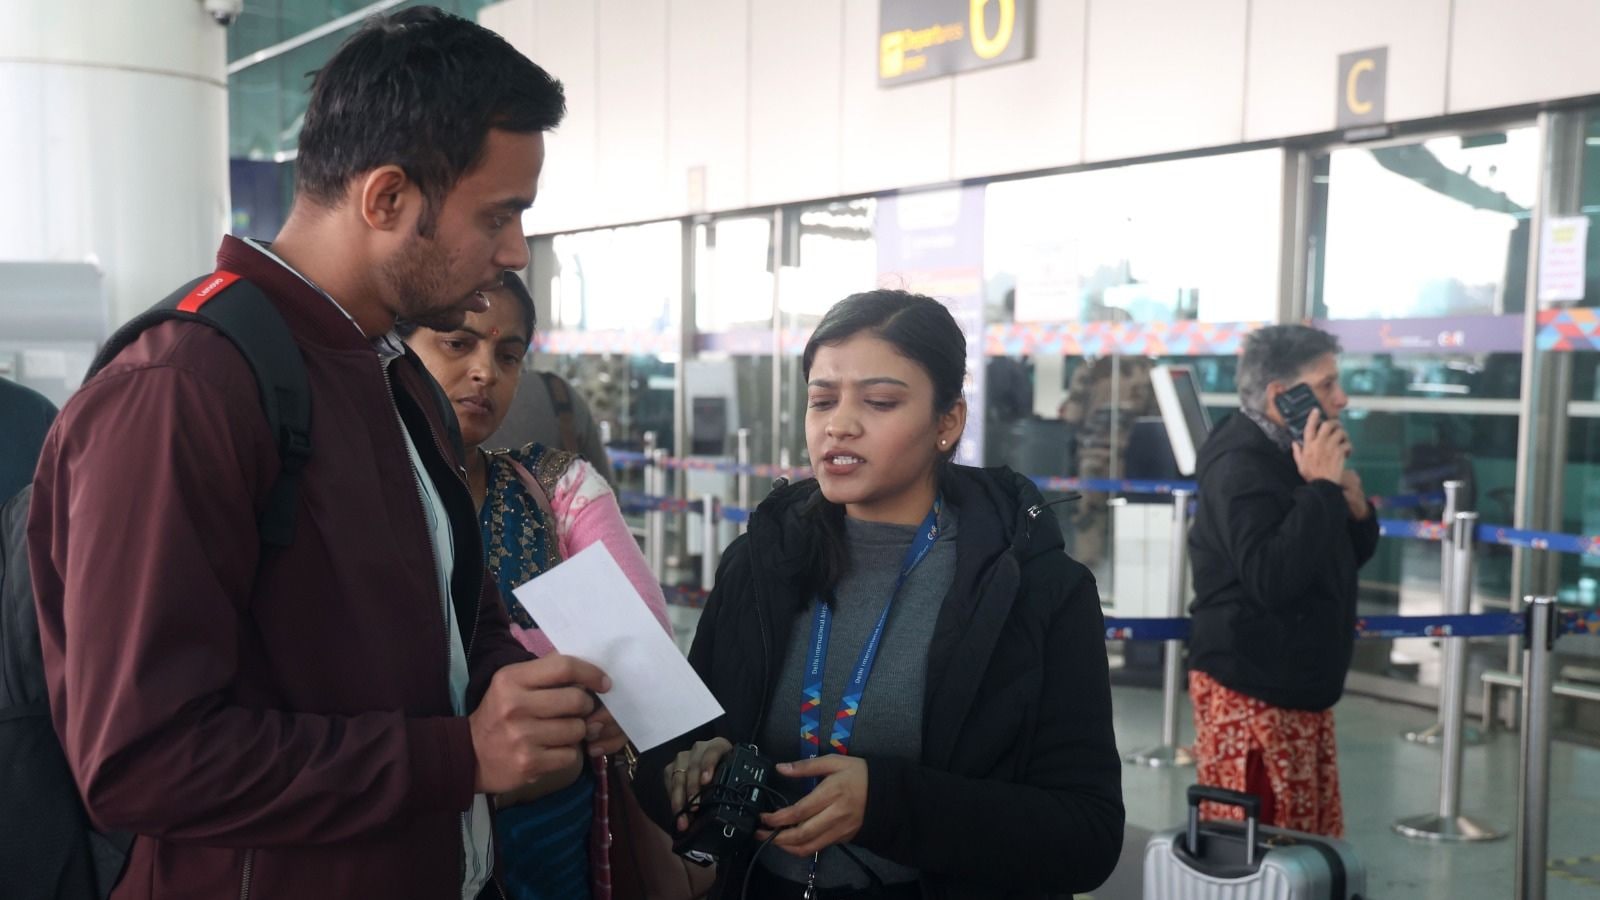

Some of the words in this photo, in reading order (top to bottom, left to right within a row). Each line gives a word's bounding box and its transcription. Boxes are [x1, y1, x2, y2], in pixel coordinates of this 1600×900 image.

[1346, 57, 1376, 115] C
[196, 278, 224, 297] Lenovo
[814, 620, 825, 658] International
[811, 658, 820, 675] Delhi
